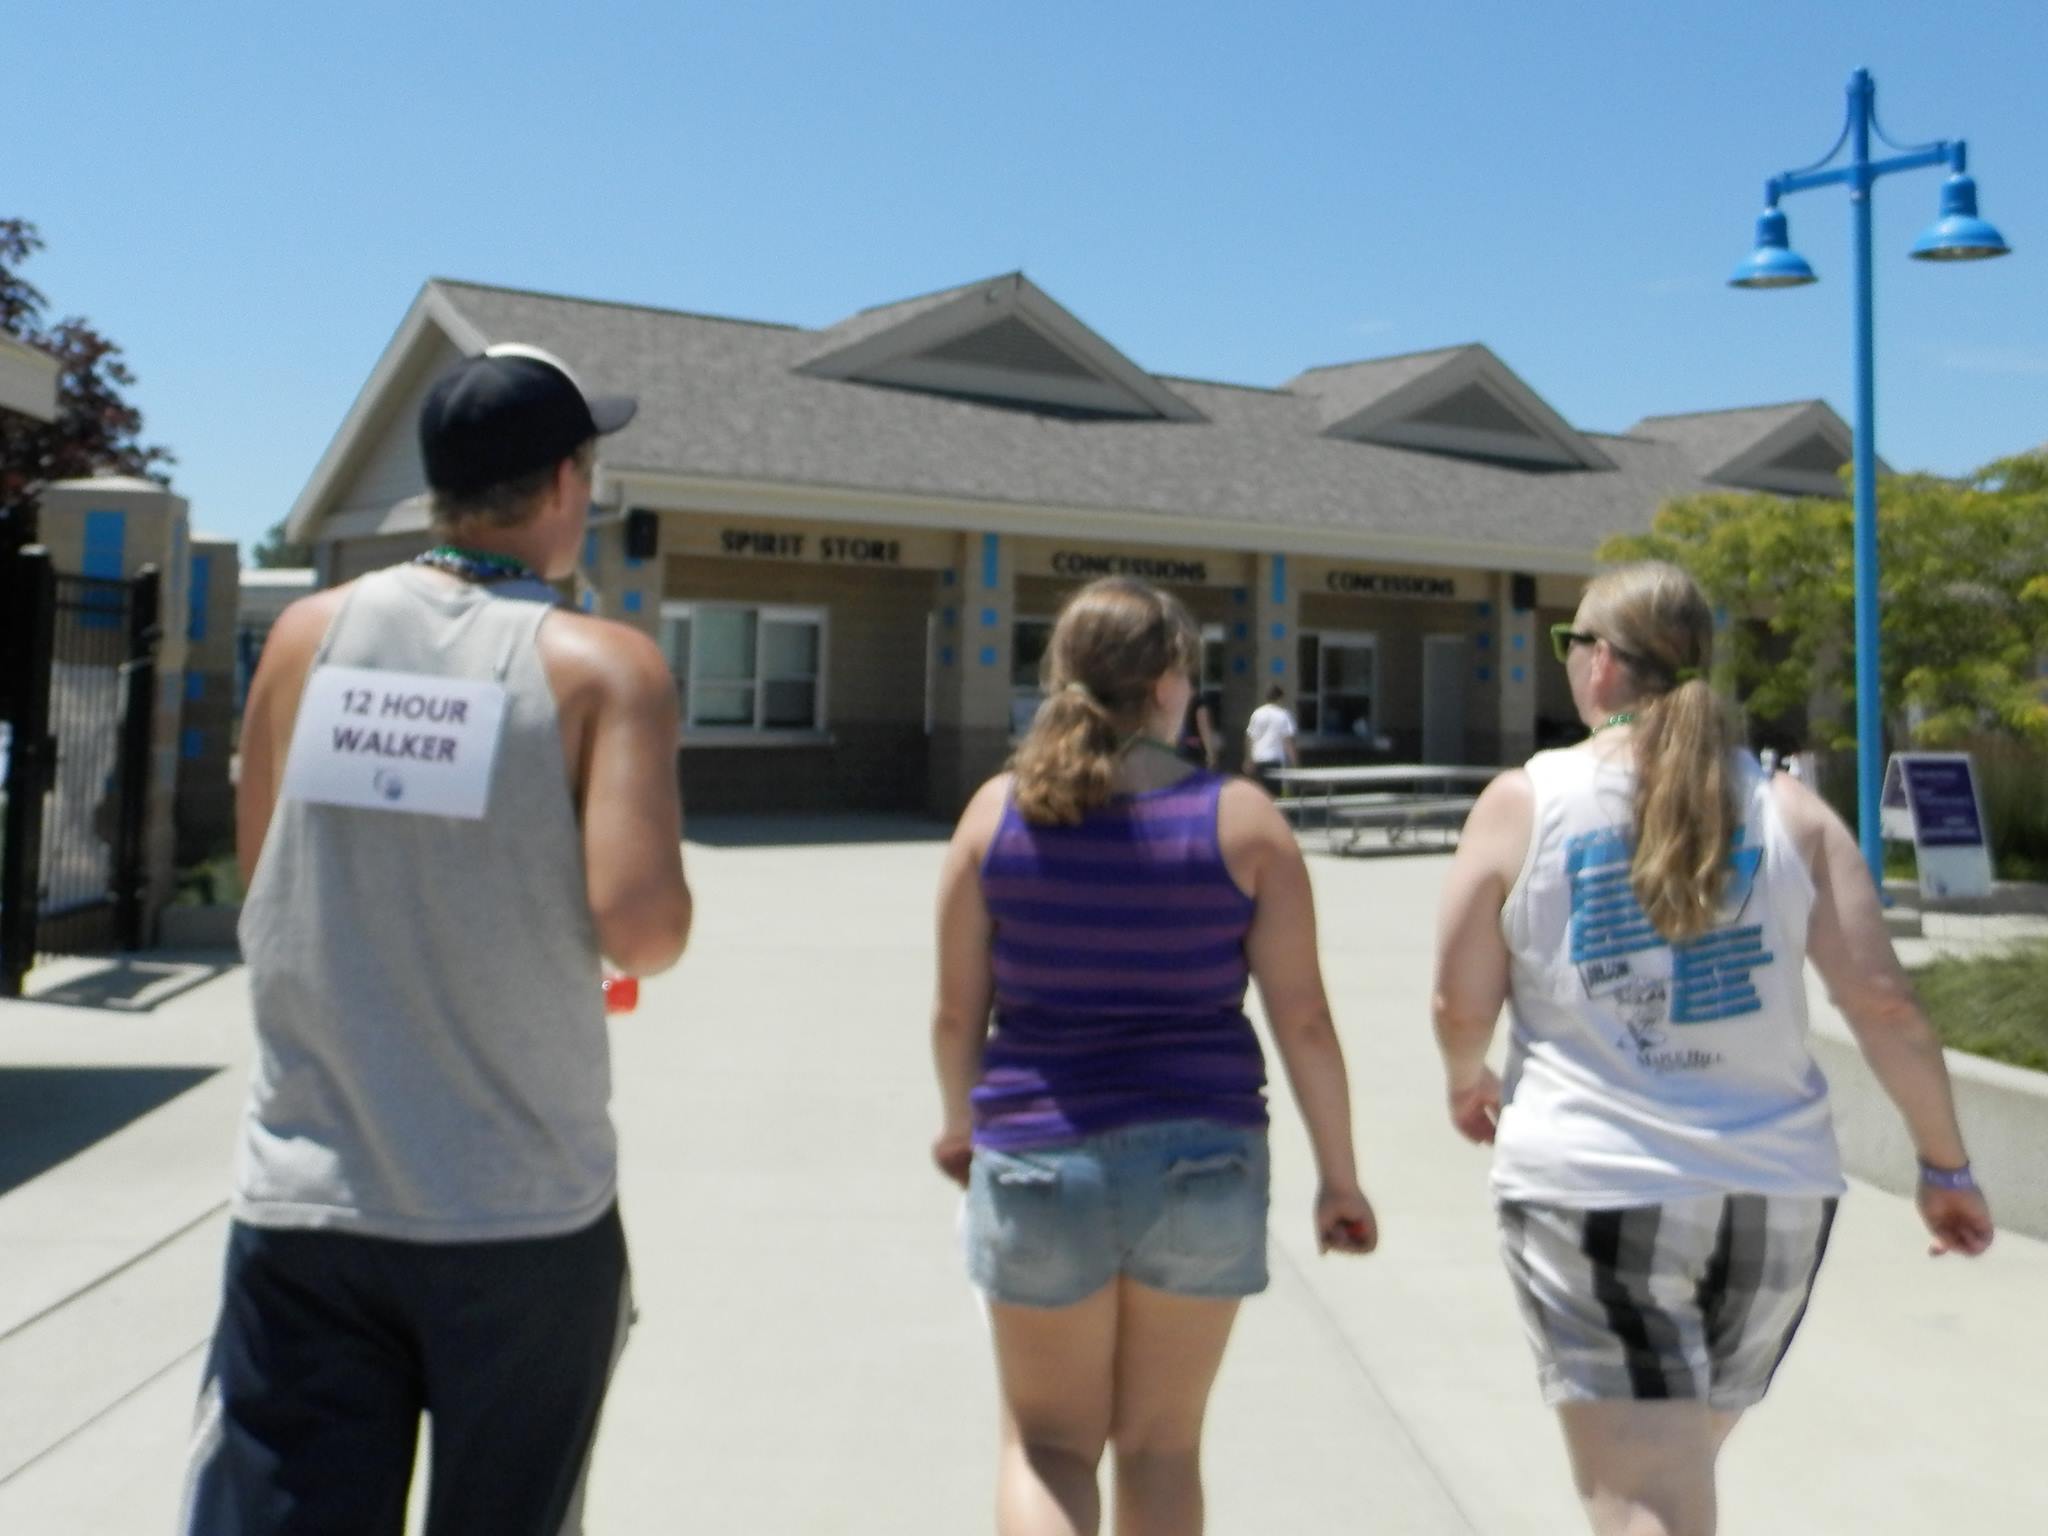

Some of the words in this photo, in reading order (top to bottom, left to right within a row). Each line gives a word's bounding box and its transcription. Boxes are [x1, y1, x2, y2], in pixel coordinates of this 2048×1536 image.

[721, 529, 803, 556] SPIRIT
[820, 536, 900, 561] STORE
[1052, 551, 1207, 580] CONCESSIONS
[1327, 571, 1455, 597] CONCESSIONS
[341, 688, 372, 716] 12
[379, 692, 468, 724] HOUR
[332, 725, 457, 764] WALKER
